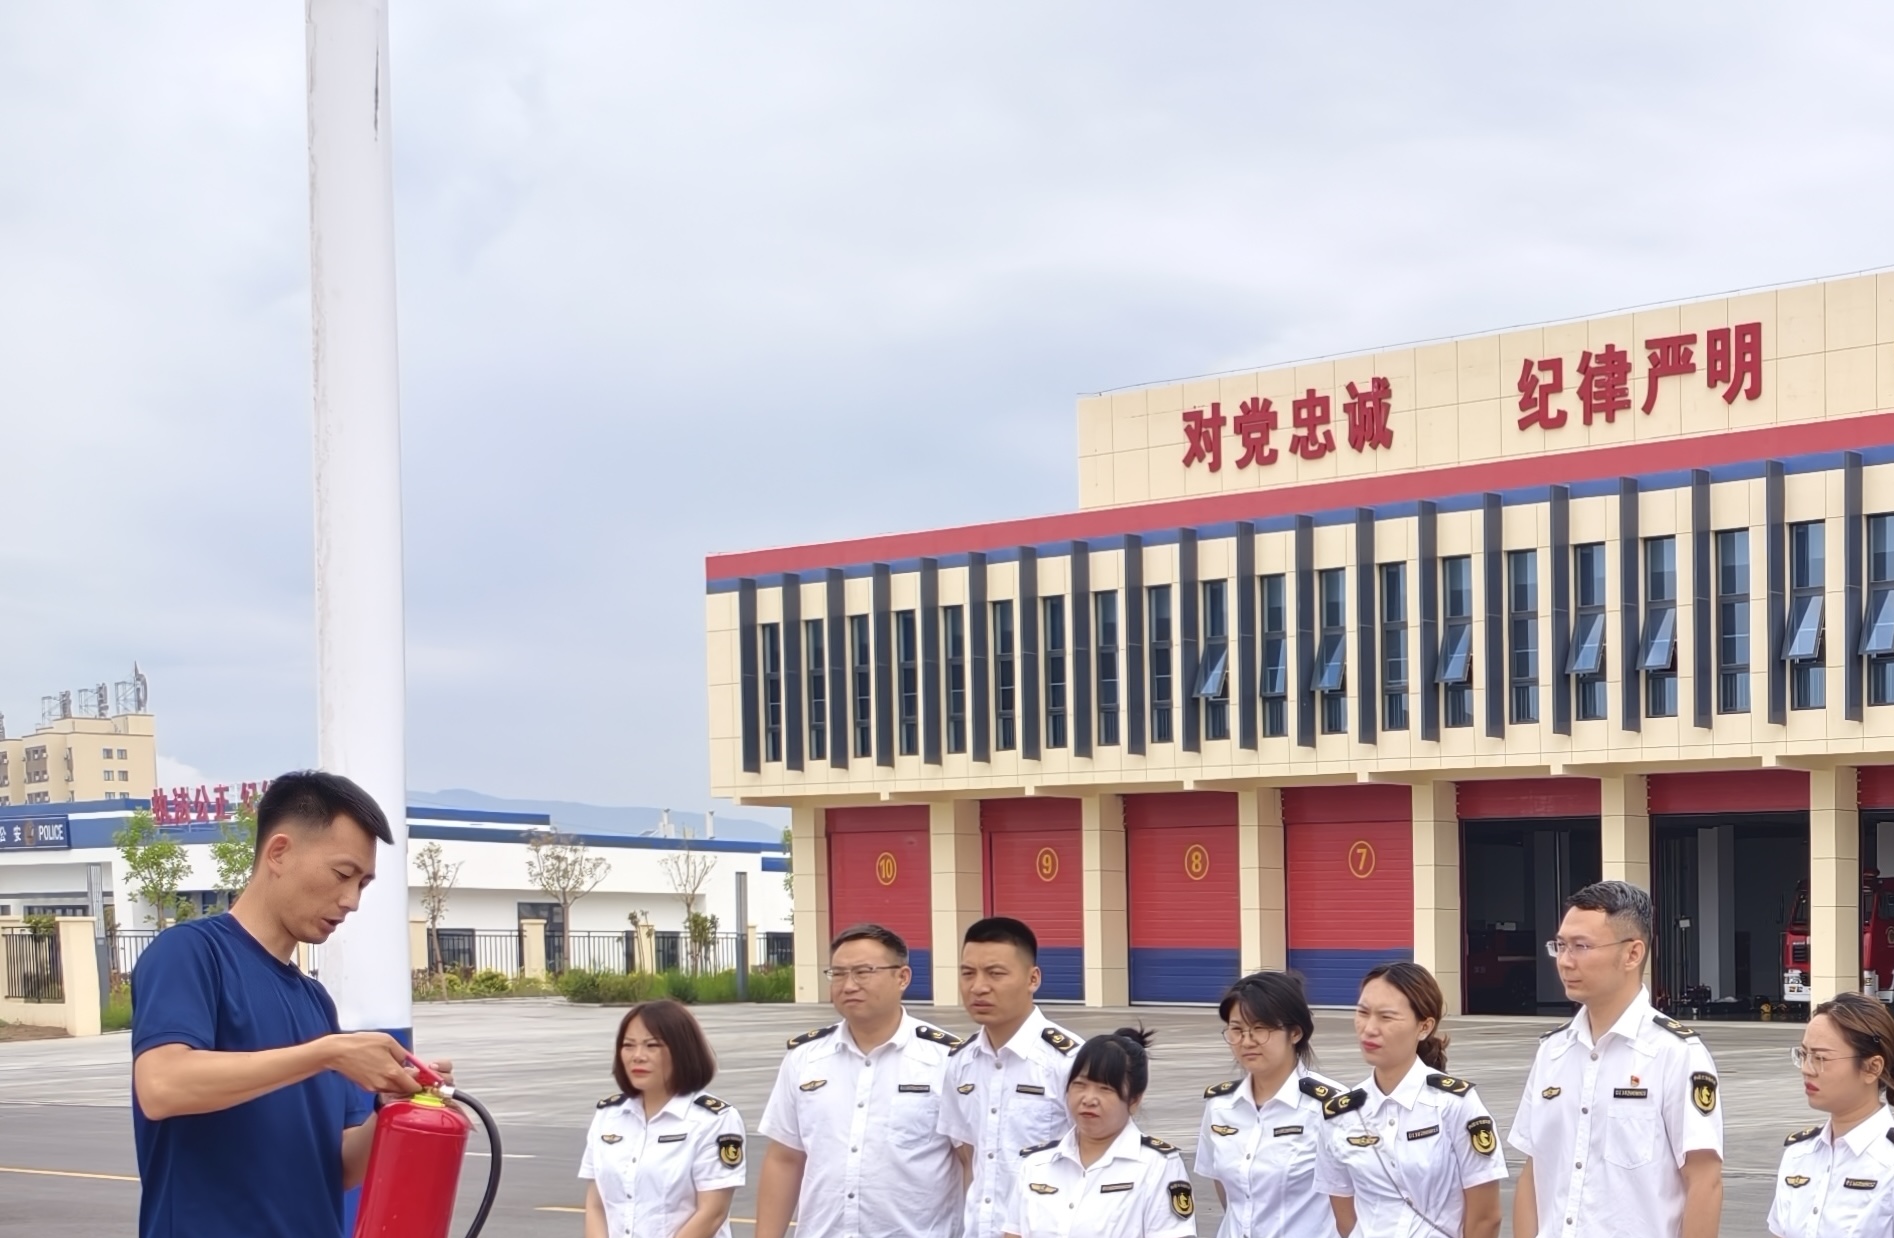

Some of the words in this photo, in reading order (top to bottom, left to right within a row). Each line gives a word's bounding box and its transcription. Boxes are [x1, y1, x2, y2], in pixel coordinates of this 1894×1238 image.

[1517, 321, 1763, 431] 纪律严明
[1181, 376, 1393, 473] 对党忠诚
[151, 784, 231, 824] 执法公正
[38, 824, 65, 841] POLICE
[879, 858, 893, 879] 10
[1042, 854, 1052, 874] 9
[1191, 851, 1202, 872] 8
[1356, 848, 1367, 870] 7
